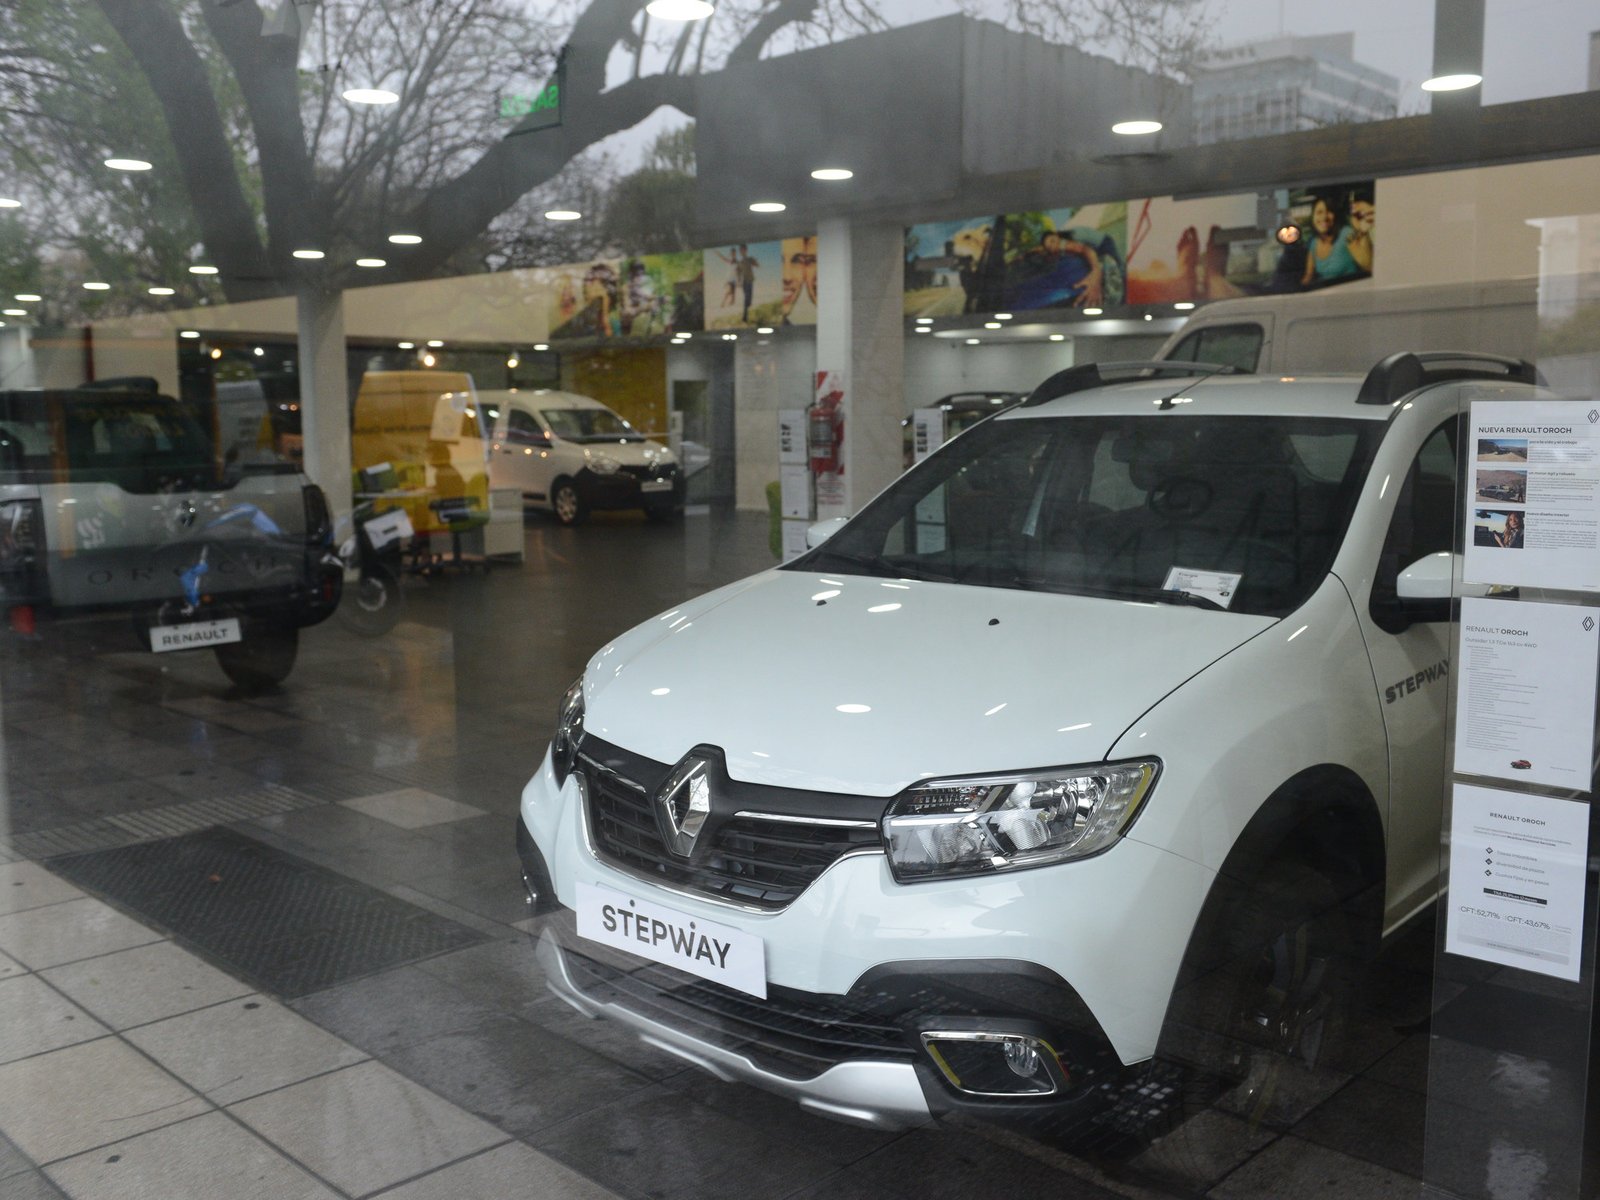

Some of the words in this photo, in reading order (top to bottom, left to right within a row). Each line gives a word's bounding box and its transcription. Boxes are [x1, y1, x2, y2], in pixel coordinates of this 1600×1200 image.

[1478, 426, 1505, 434] NUEVA
[1506, 426, 1541, 434] RENAULT
[162, 628, 228, 646] RENAULT
[1465, 625, 1500, 634] RENAULT
[1500, 628, 1529, 637] OROCH
[1385, 657, 1452, 705] STEPWAY
[1489, 812, 1520, 822] RENAULT
[1521, 817, 1546, 826] OROCH
[602, 903, 731, 970] STEPWAY
